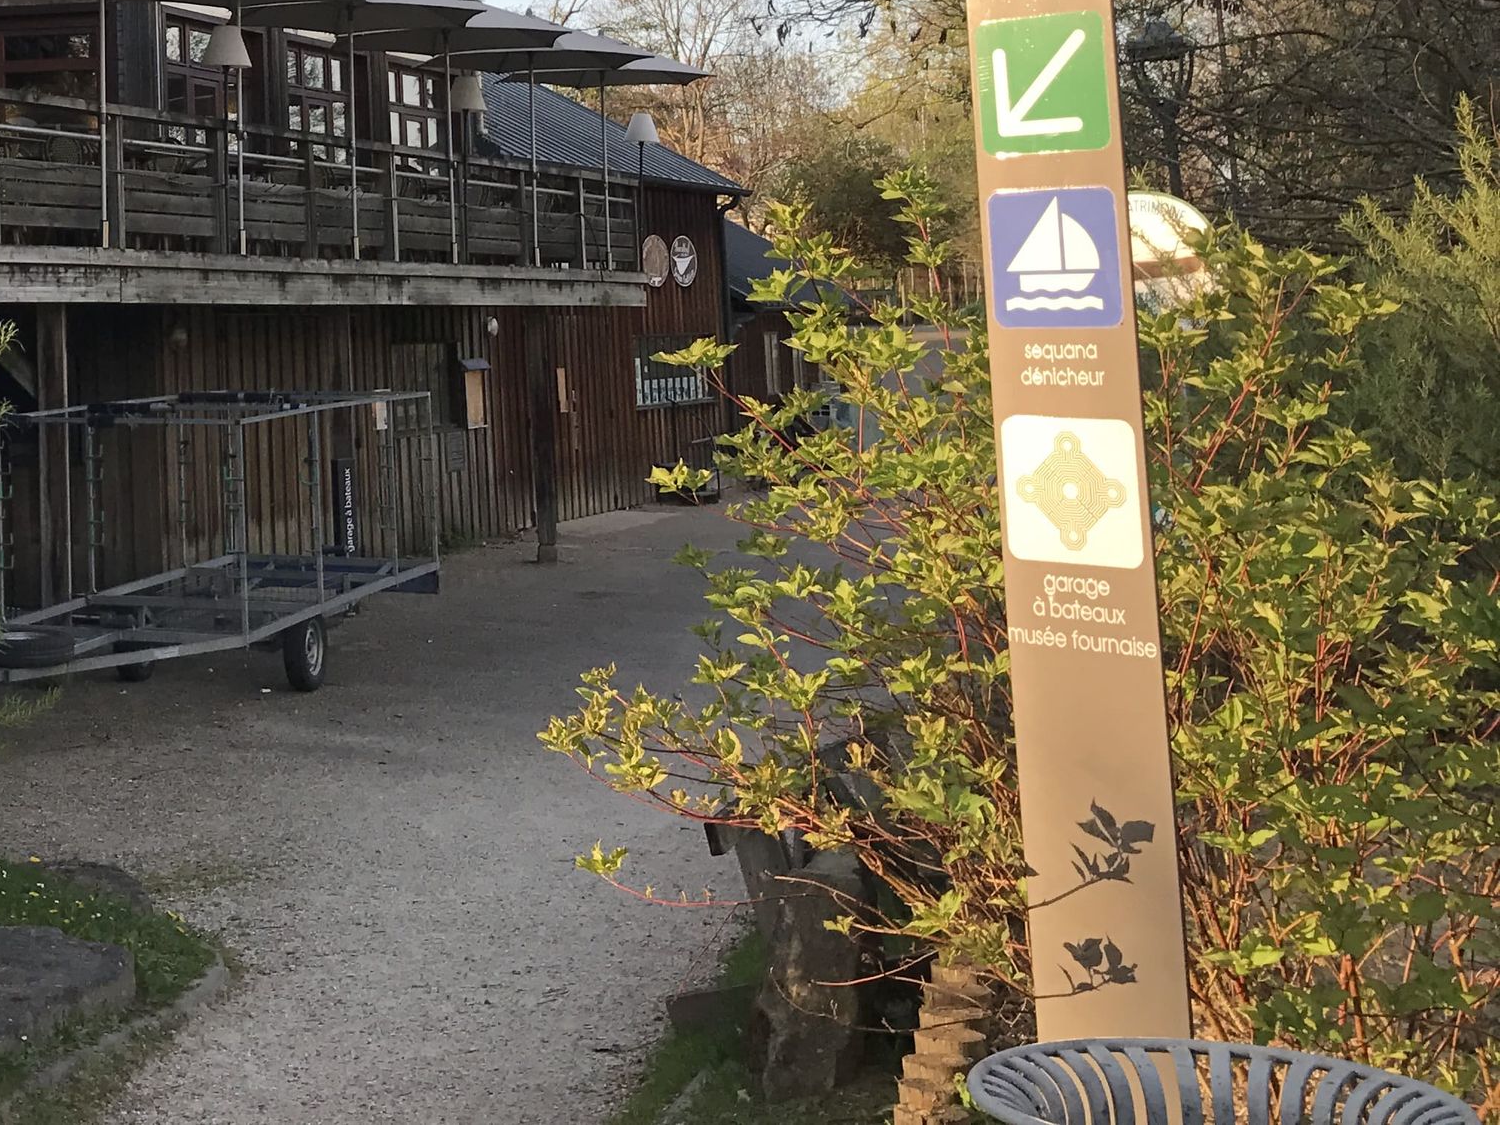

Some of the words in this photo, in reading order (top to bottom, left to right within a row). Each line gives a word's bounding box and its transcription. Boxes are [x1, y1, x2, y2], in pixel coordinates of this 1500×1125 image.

[1024, 343, 1098, 363] sequana
[1021, 366, 1105, 386] dénicheur
[344, 467, 352, 508] bateaux
[347, 517, 355, 552] garage
[1043, 573, 1110, 600] garage
[1033, 596, 1046, 617] à
[1048, 595, 1126, 625] bateaux
[1008, 626, 1067, 648] musée
[1071, 630, 1157, 658] fournaise
